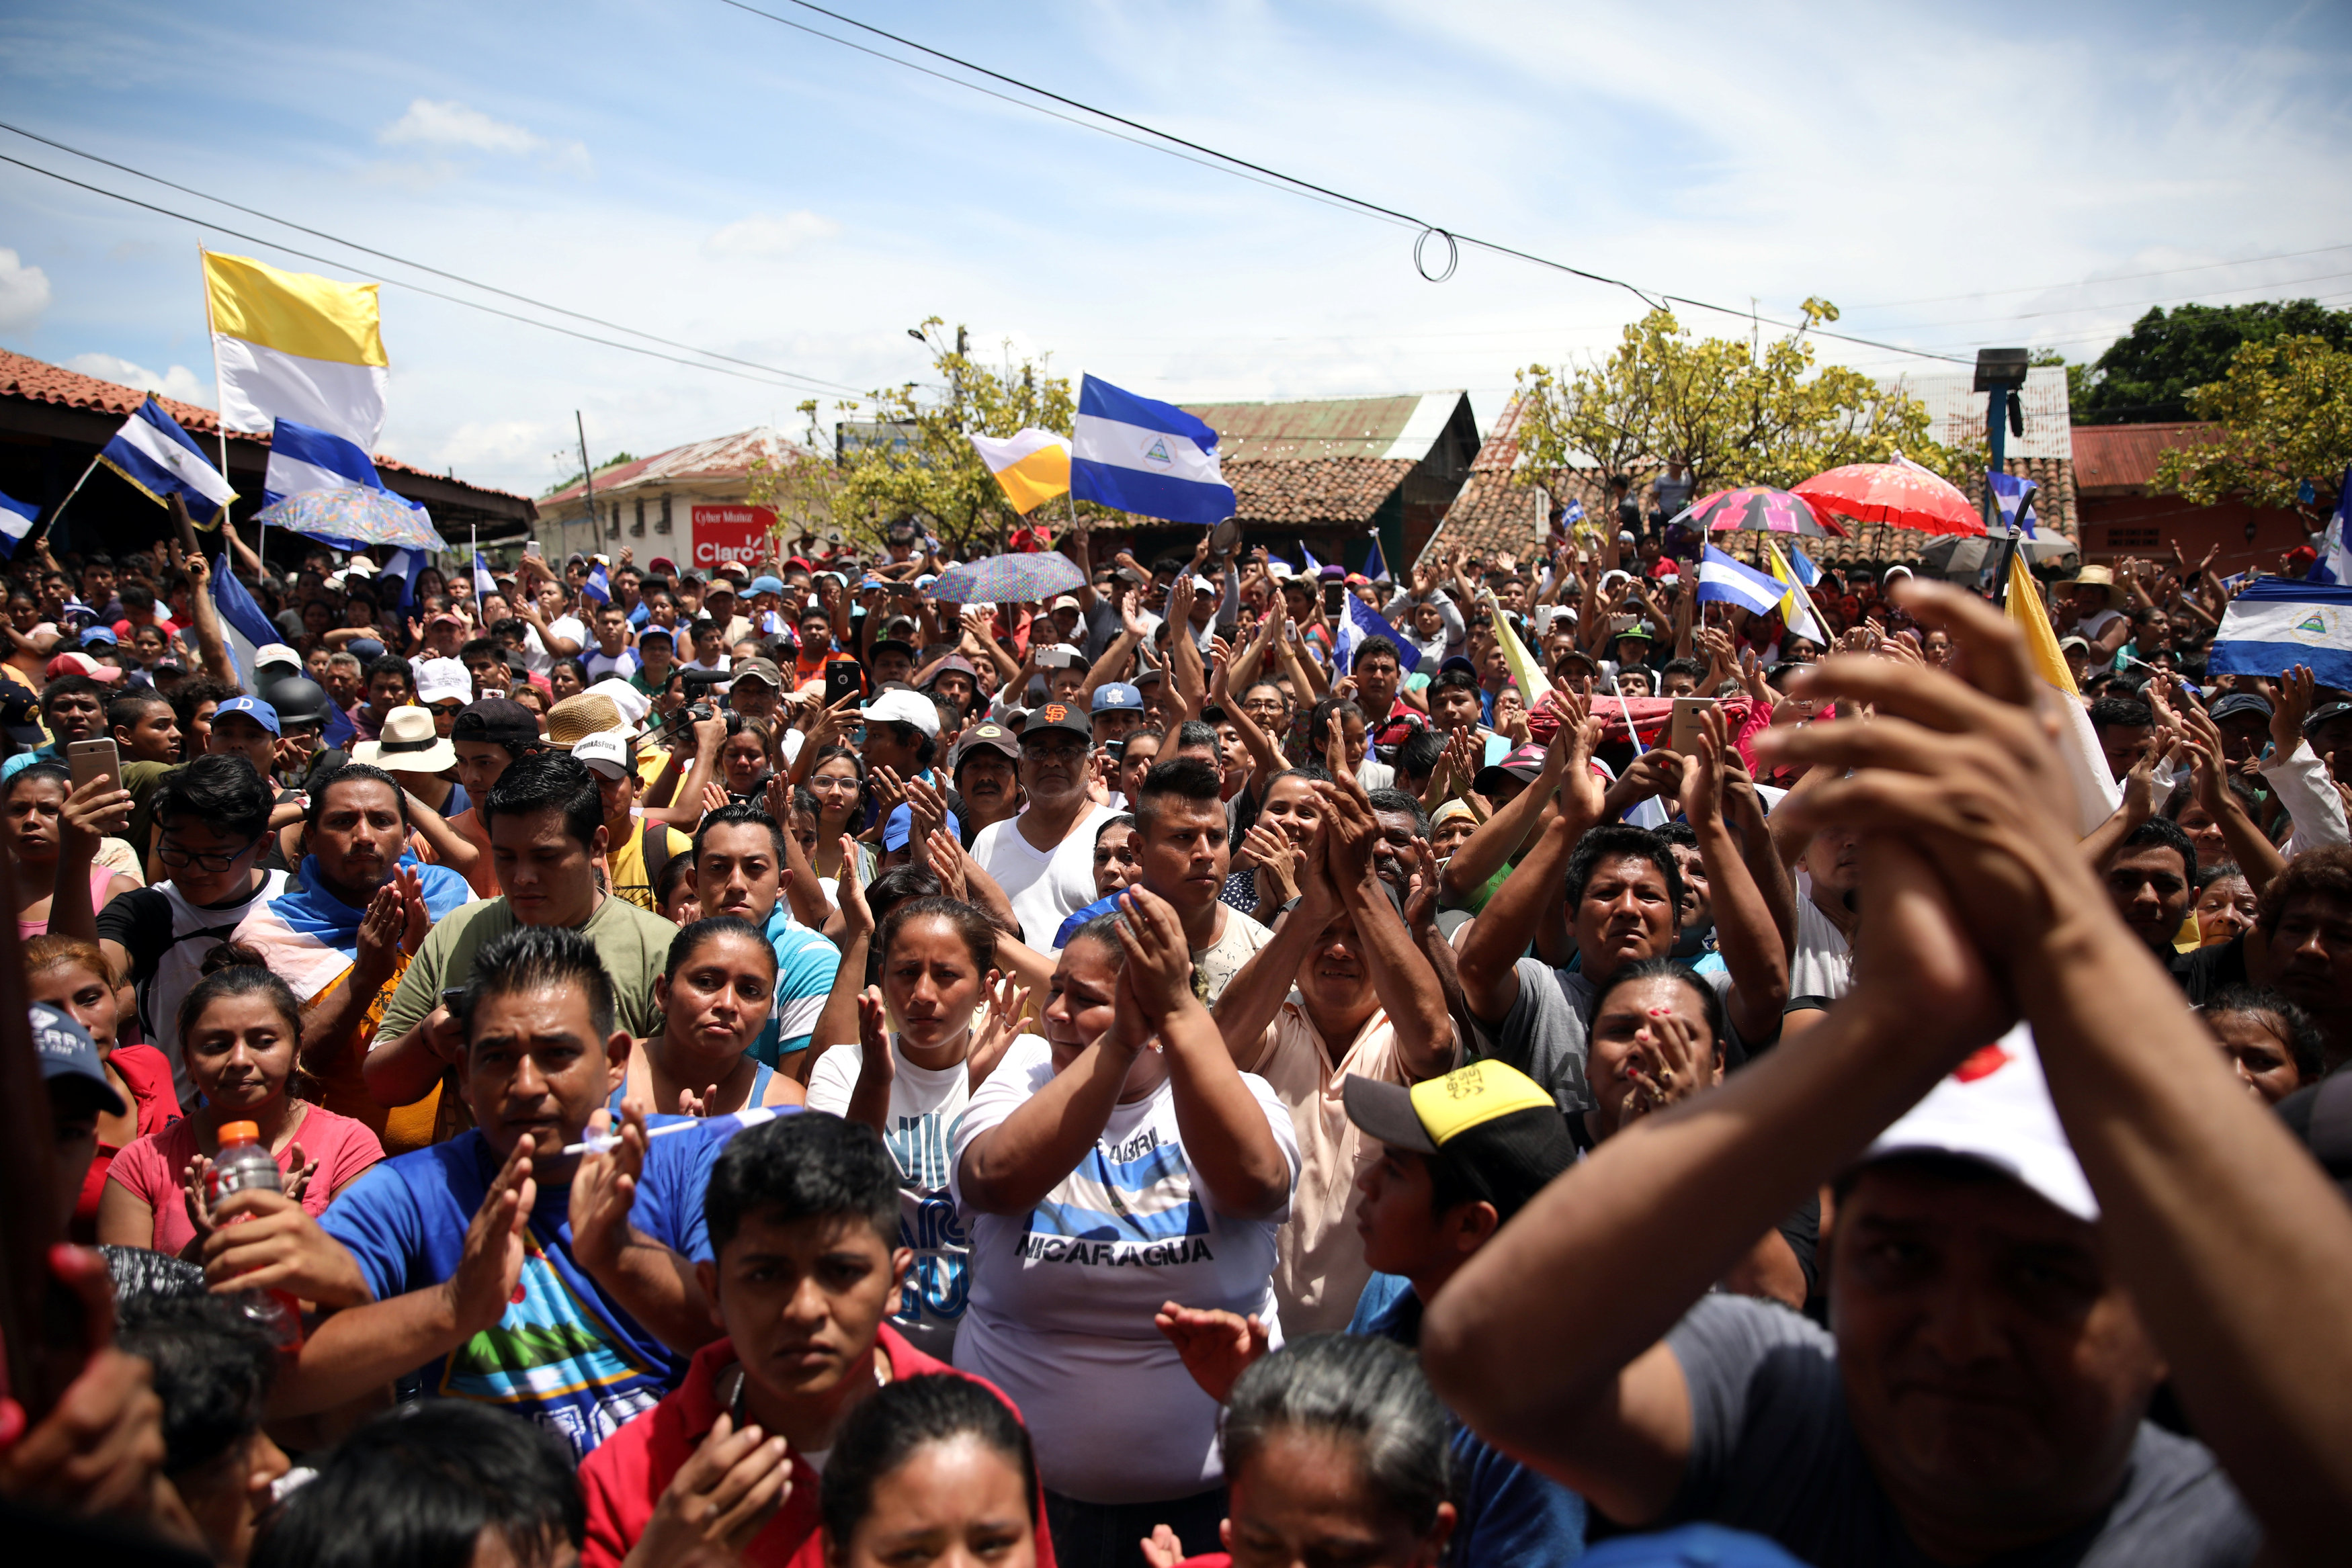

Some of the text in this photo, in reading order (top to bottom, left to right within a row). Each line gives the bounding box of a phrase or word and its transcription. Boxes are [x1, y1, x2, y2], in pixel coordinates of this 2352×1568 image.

[695, 511, 721, 527] Cyber
[696, 542, 755, 562] Claro
[235, 697, 254, 710] D
[1109, 1126, 1169, 1164] ABRIL
[1014, 1234, 1214, 1267] NICARAGUA
